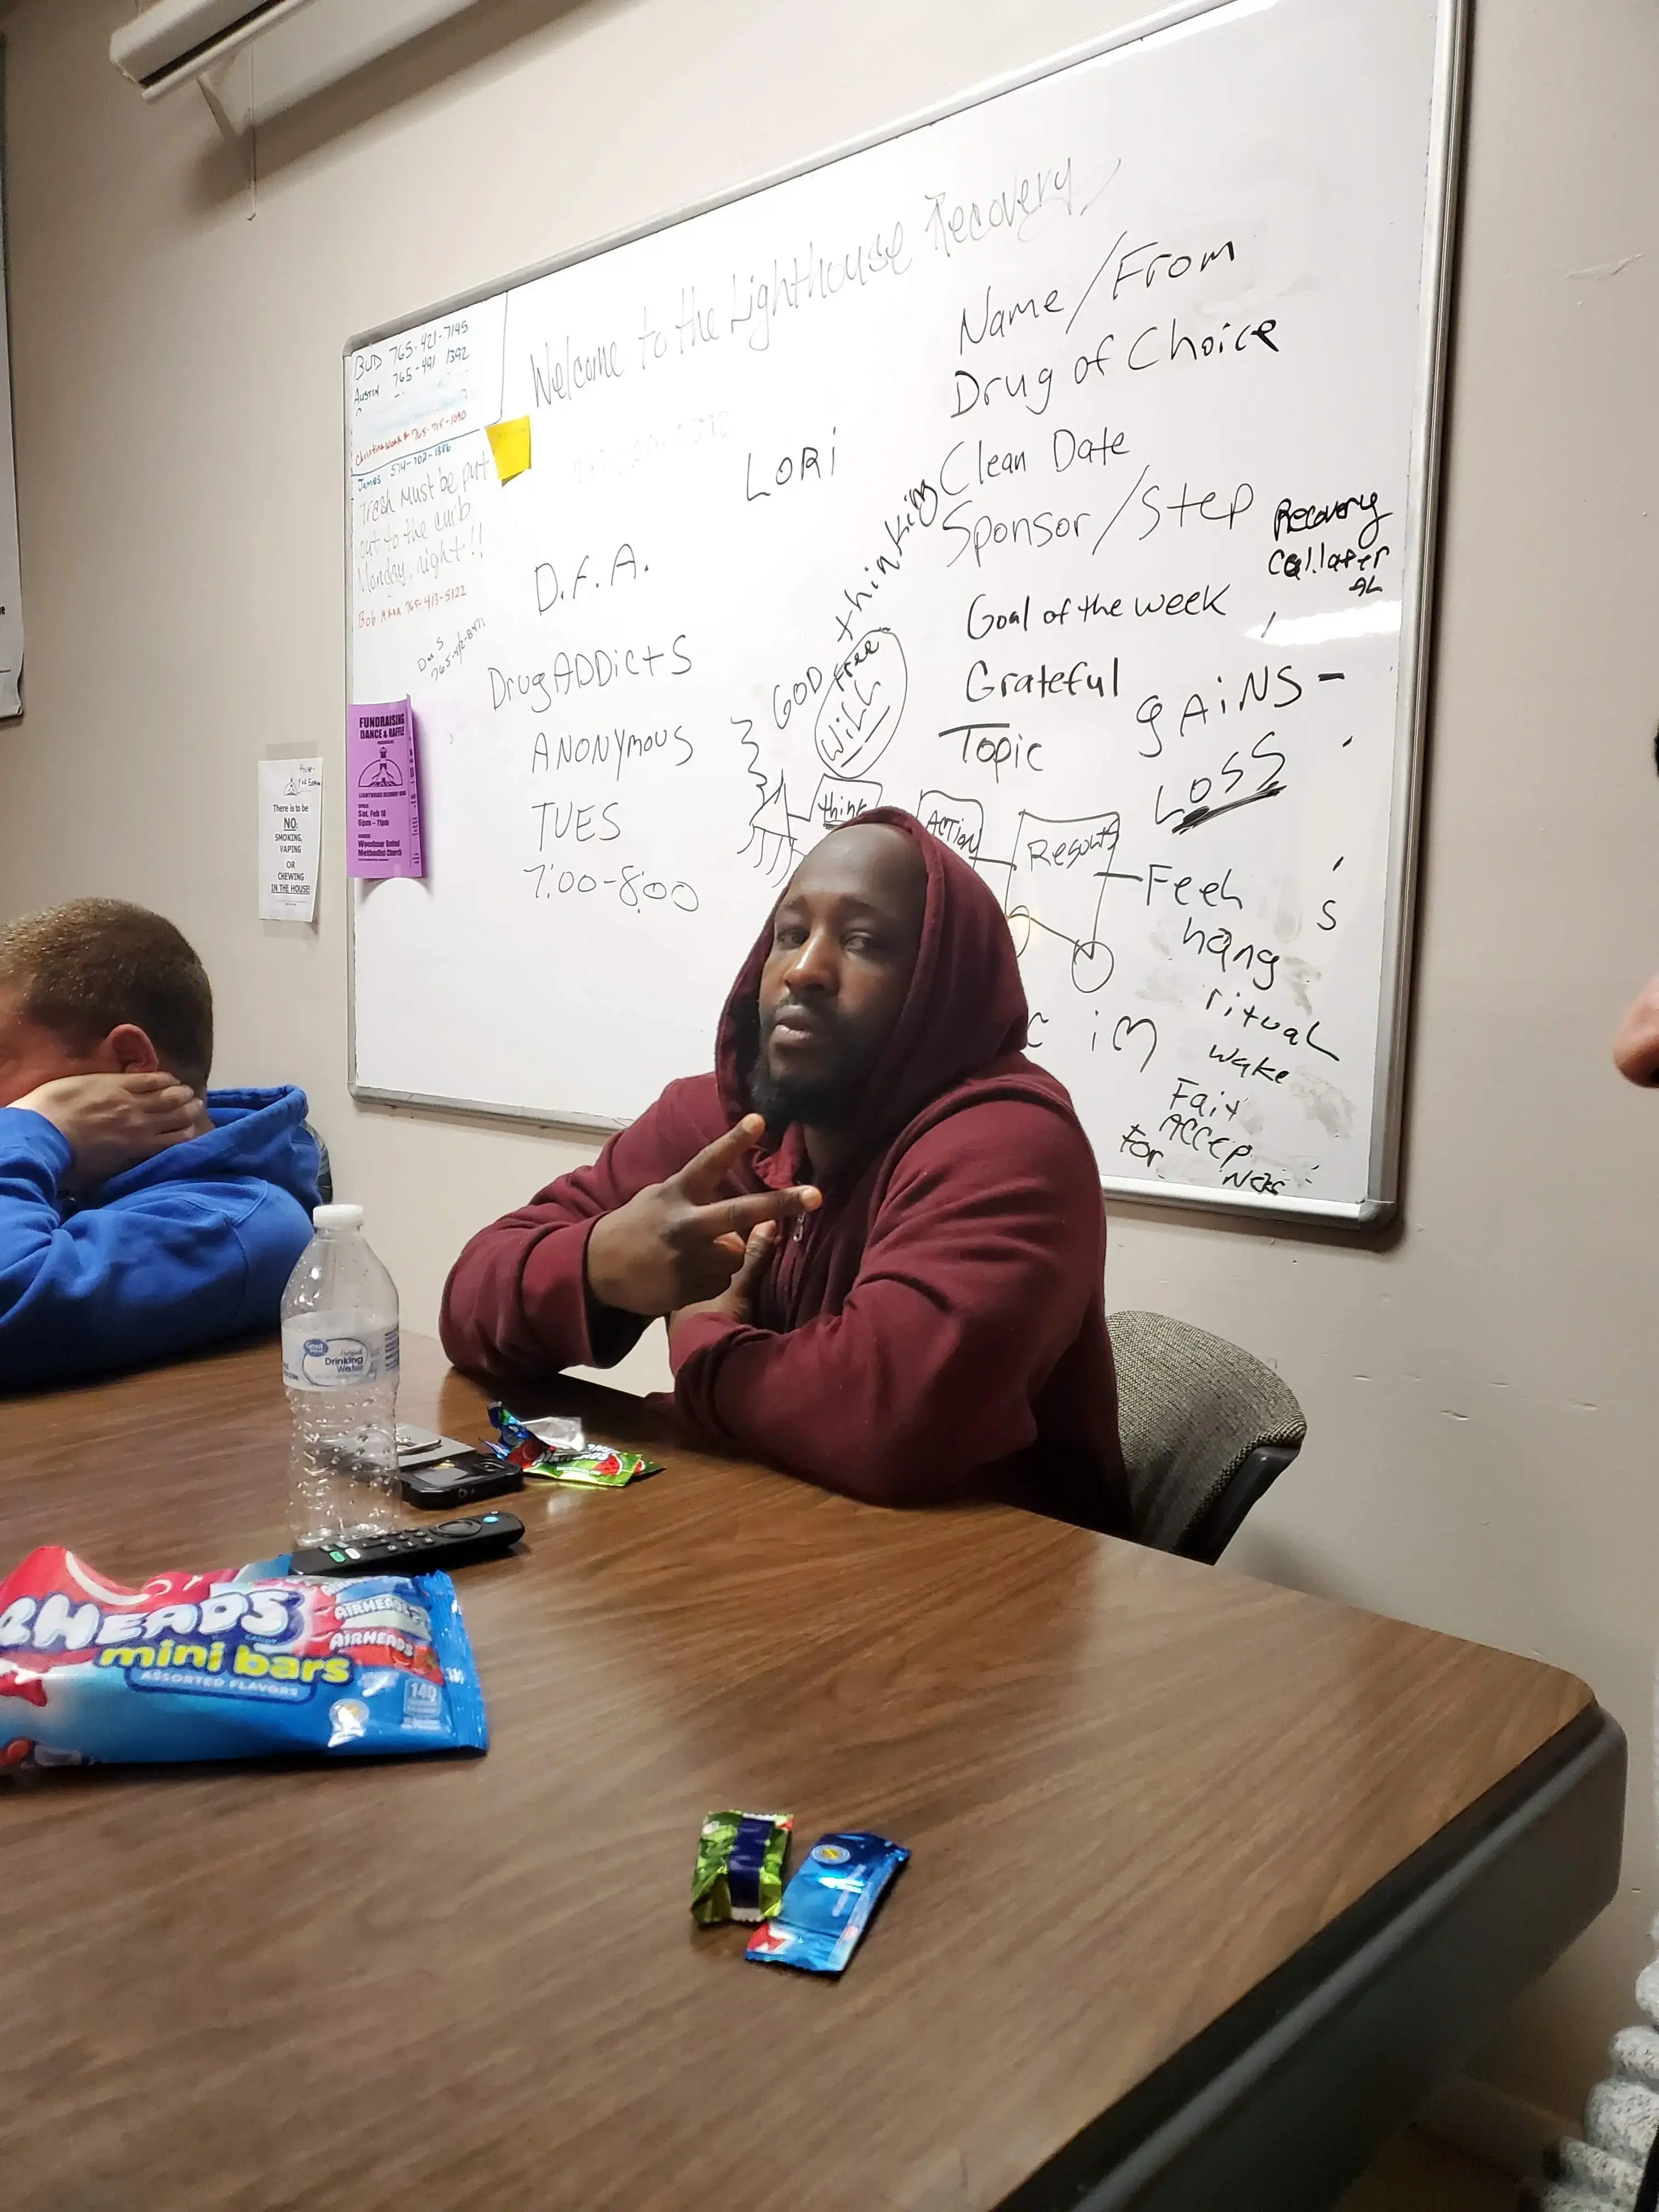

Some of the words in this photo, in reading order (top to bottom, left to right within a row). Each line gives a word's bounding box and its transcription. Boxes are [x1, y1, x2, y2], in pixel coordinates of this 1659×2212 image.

[530, 335, 624, 408] Welcome
[638, 306, 667, 370] to
[675, 286, 720, 354] the
[731, 221, 913, 352] Lighthouse
[356, 354, 383, 381] BUD
[950, 367, 1053, 418] Drug
[1074, 334, 1114, 385] of
[1128, 318, 1279, 370] Choice
[438, 466, 459, 494] be
[462, 450, 490, 493] put
[939, 440, 1026, 495] Clean
[1053, 426, 1130, 473] Date
[360, 530, 380, 559] out
[383, 524, 400, 551] to
[403, 518, 429, 544] the
[434, 496, 471, 532] curb
[967, 593, 1030, 640] Goal
[1043, 598, 1073, 625] of
[1077, 592, 1122, 622] the
[966, 656, 1120, 703] Grateful
[773, 665, 823, 730] GOD
[359, 713, 405, 728] FUNDRAISING
[360, 729, 382, 740] DANCE
[383, 730, 388, 738] &
[389, 726, 405, 738] RAFFLE
[937, 721, 1044, 784] Topic
[273, 804, 289, 812] There
[290, 804, 295, 812] is
[295, 804, 301, 812] to
[302, 804, 309, 812] be
[275, 833, 302, 843] SMOKING,
[531, 801, 621, 853] TUES
[280, 845, 302, 854] VAPING
[278, 872, 304, 881] CHEWING
[286, 861, 296, 869] OR
[271, 883, 278, 892] IN
[279, 884, 289, 893] THE
[325, 1356, 364, 1365] Drinking
[336, 1364, 364, 1373] Water
[330, 1630, 414, 1657] AIRHEADS
[99, 1638, 227, 1673] mini
[234, 1644, 351, 1683] bars
[140, 1670, 224, 1688] ASSORTED
[229, 1679, 298, 1695] FLAVORS
